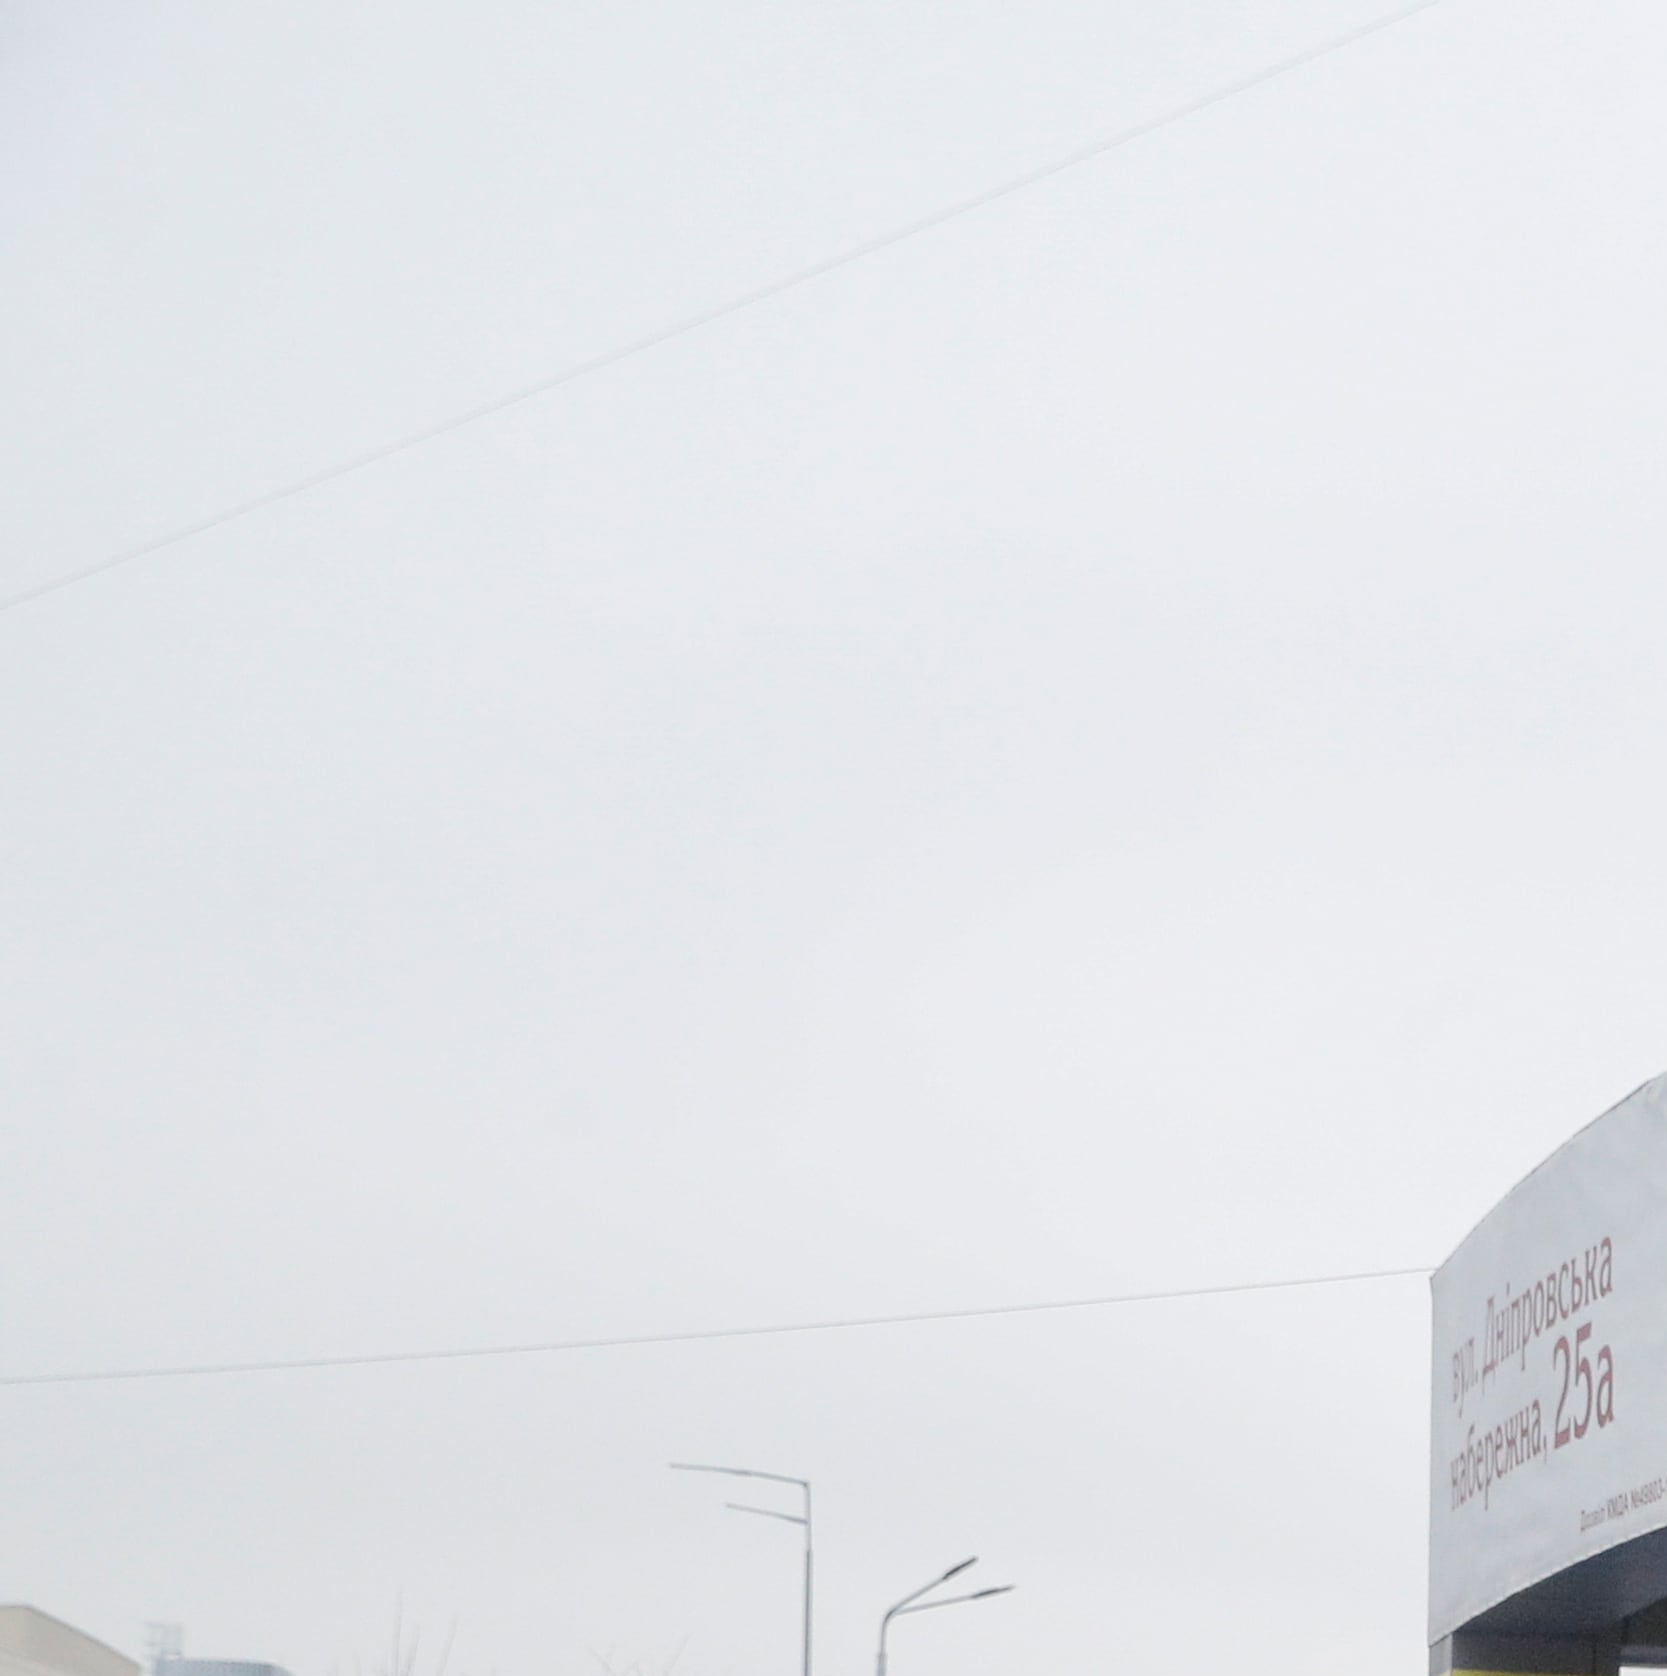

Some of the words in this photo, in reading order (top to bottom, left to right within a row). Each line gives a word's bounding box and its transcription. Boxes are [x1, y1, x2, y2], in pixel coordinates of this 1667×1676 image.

[1481, 1235, 1613, 1397] Дніпровська
[1450, 1399, 1548, 1512] набережна,
[1553, 1321, 1615, 1450] 25а
